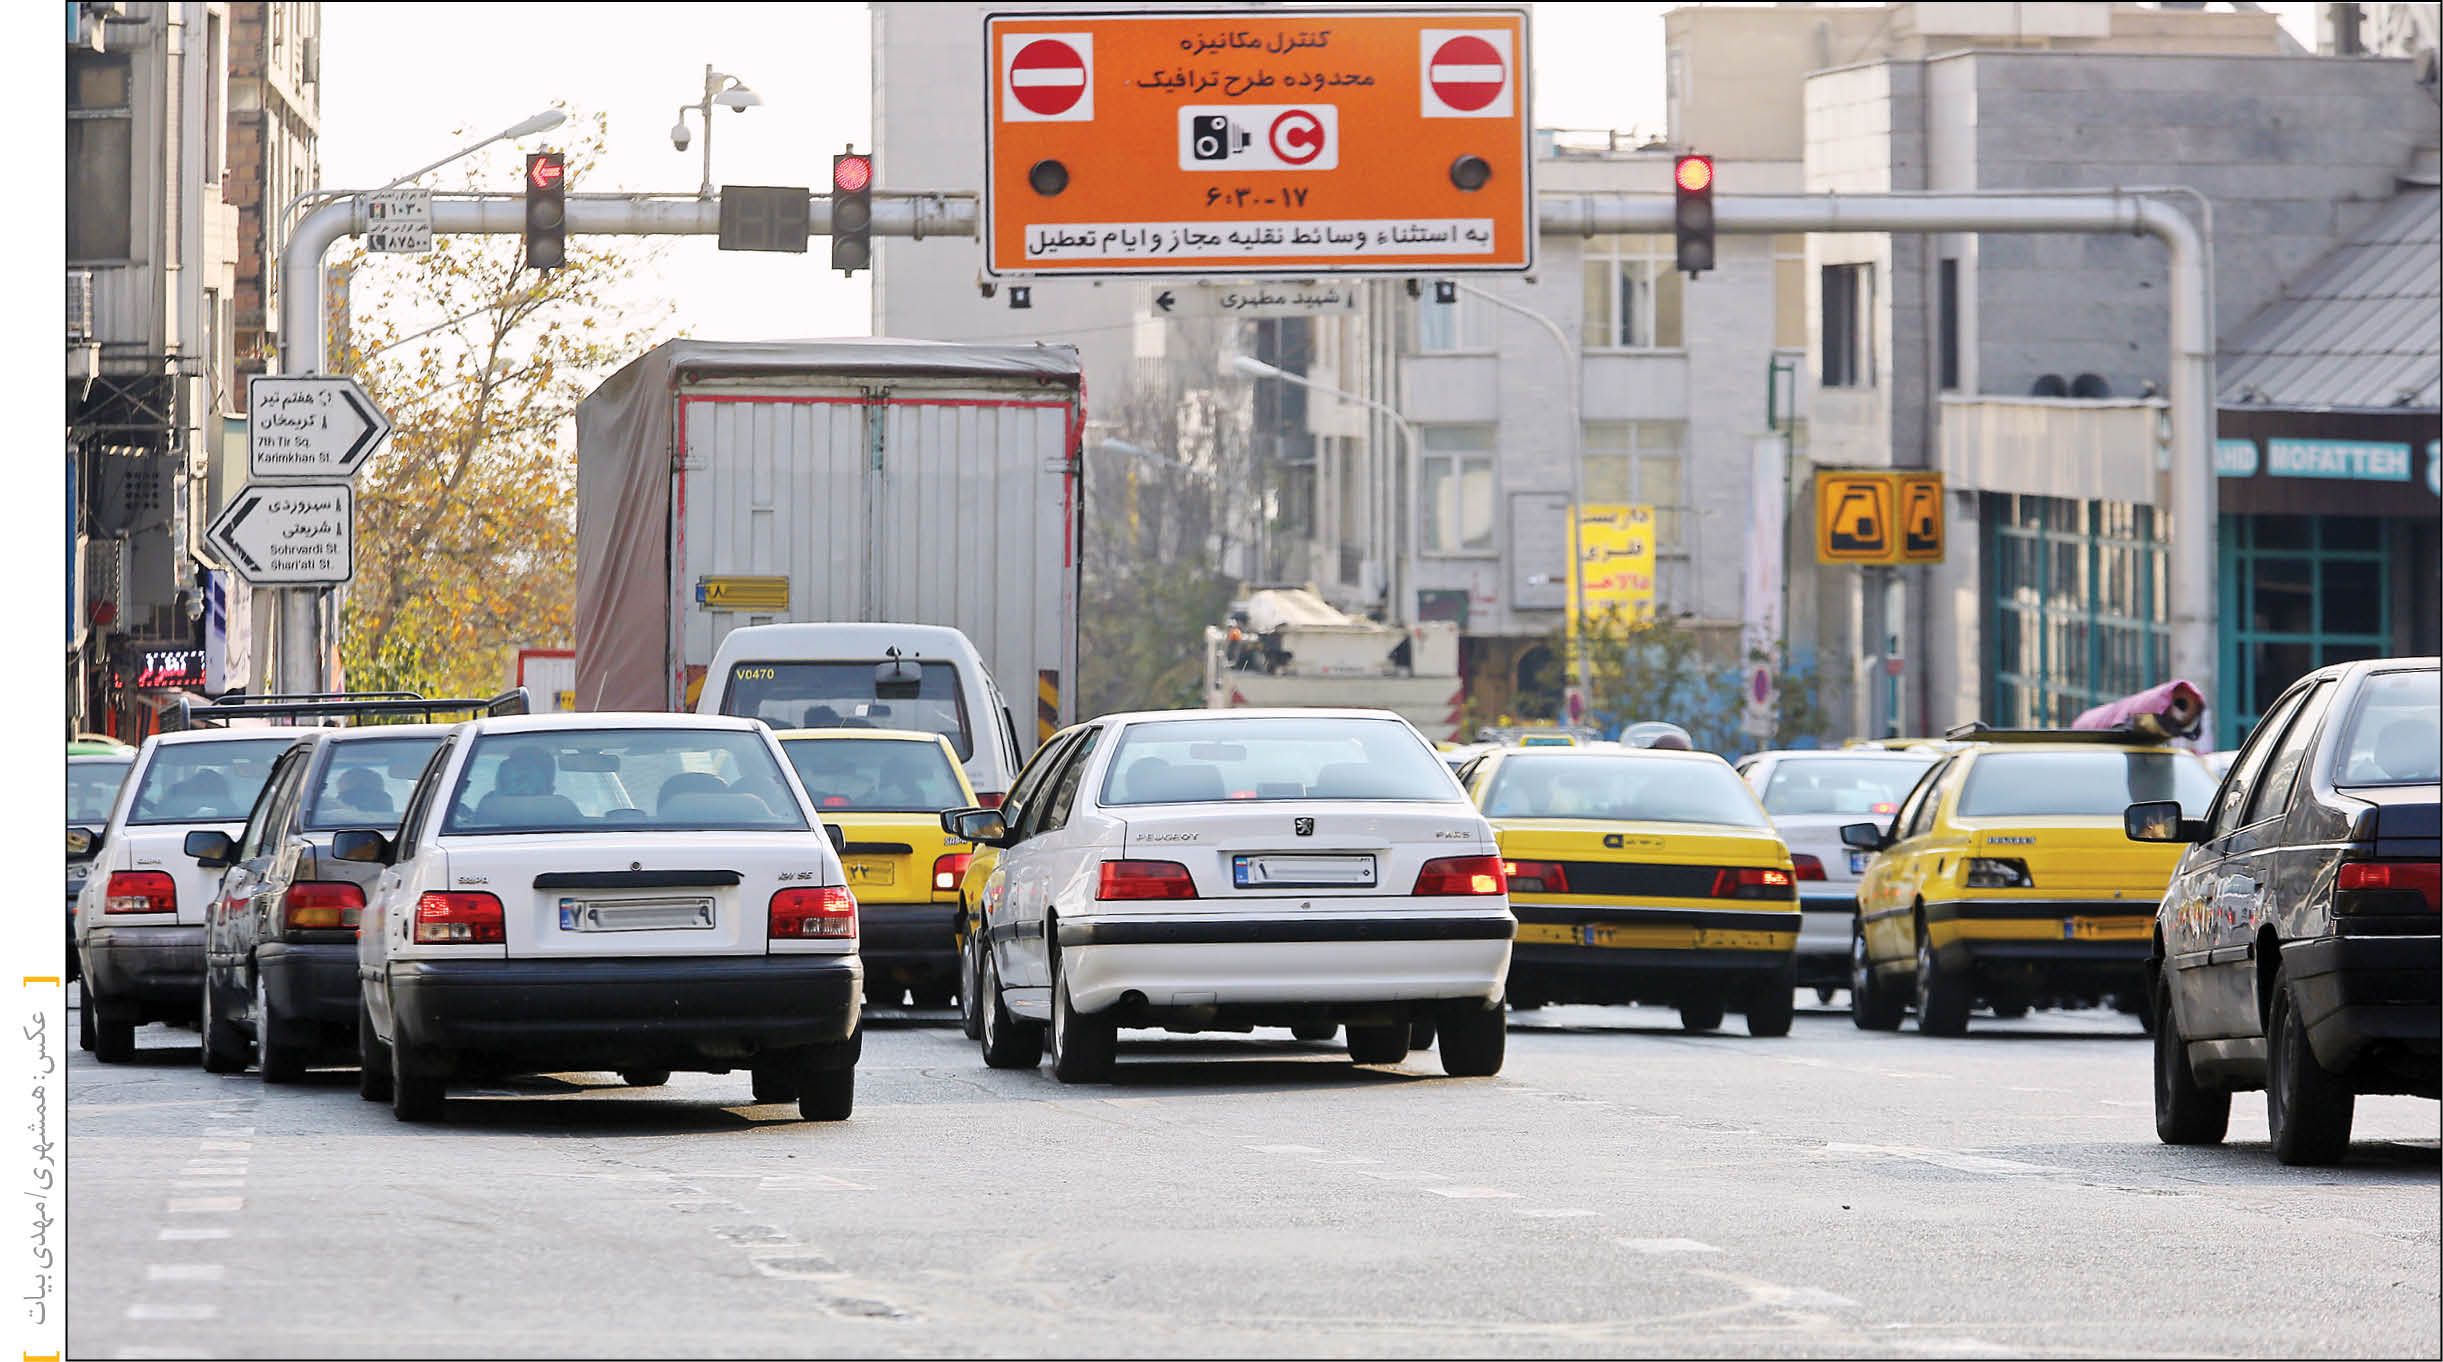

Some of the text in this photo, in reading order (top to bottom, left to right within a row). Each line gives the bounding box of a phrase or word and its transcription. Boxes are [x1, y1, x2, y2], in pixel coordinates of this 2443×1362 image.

[1180, 30, 1333, 55] کنترل مکانیزه
[1137, 67, 1376, 96] محدوده طرح ترافیک
[1029, 230, 1097, 255] تعطیل
[1102, 230, 1146, 254] ایام
[1171, 230, 1220, 252] مجاز
[1228, 229, 1284, 250] نقلیه
[1293, 226, 1367, 249] وسائط
[1466, 226, 1490, 245] به
[1220, 290, 1341, 309] شهید مطهری
[259, 391, 315, 410] هفتم تیر
[260, 413, 317, 430] کریمخان
[257, 436, 276, 447] 7th
[278, 436, 292, 447] Tir
[257, 453, 316, 464] Karimkhan
[2271, 444, 2409, 476] MOFATTEH
[268, 499, 332, 515] سهروردی
[282, 521, 332, 539] شریعتی
[736, 668, 775, 680] V0470
[1136, 832, 1200, 842] PEUGEOT
